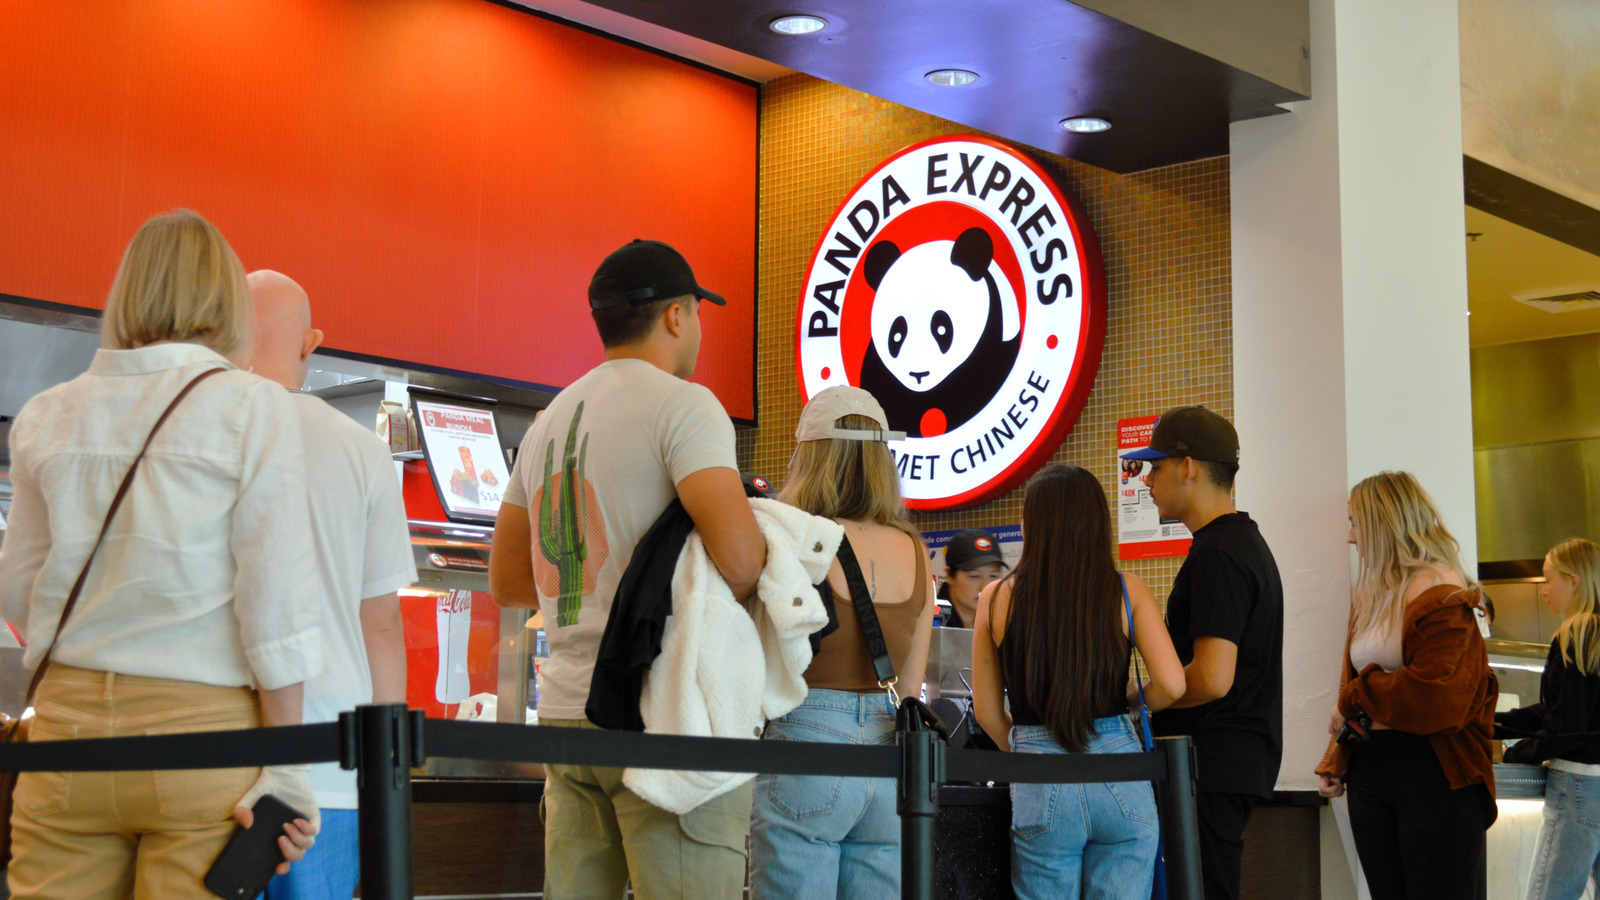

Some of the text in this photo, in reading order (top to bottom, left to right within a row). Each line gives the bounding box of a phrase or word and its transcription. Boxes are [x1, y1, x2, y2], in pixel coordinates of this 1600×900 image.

[808, 152, 1073, 338] PANDA EXPRESS
[440, 411, 485, 425] PANDA MEAL
[445, 422, 473, 432] BUNDLE
[889, 370, 1050, 481] MET CHINESE
[1121, 424, 1155, 433] DISCOVER
[480, 490, 504, 502] $14
